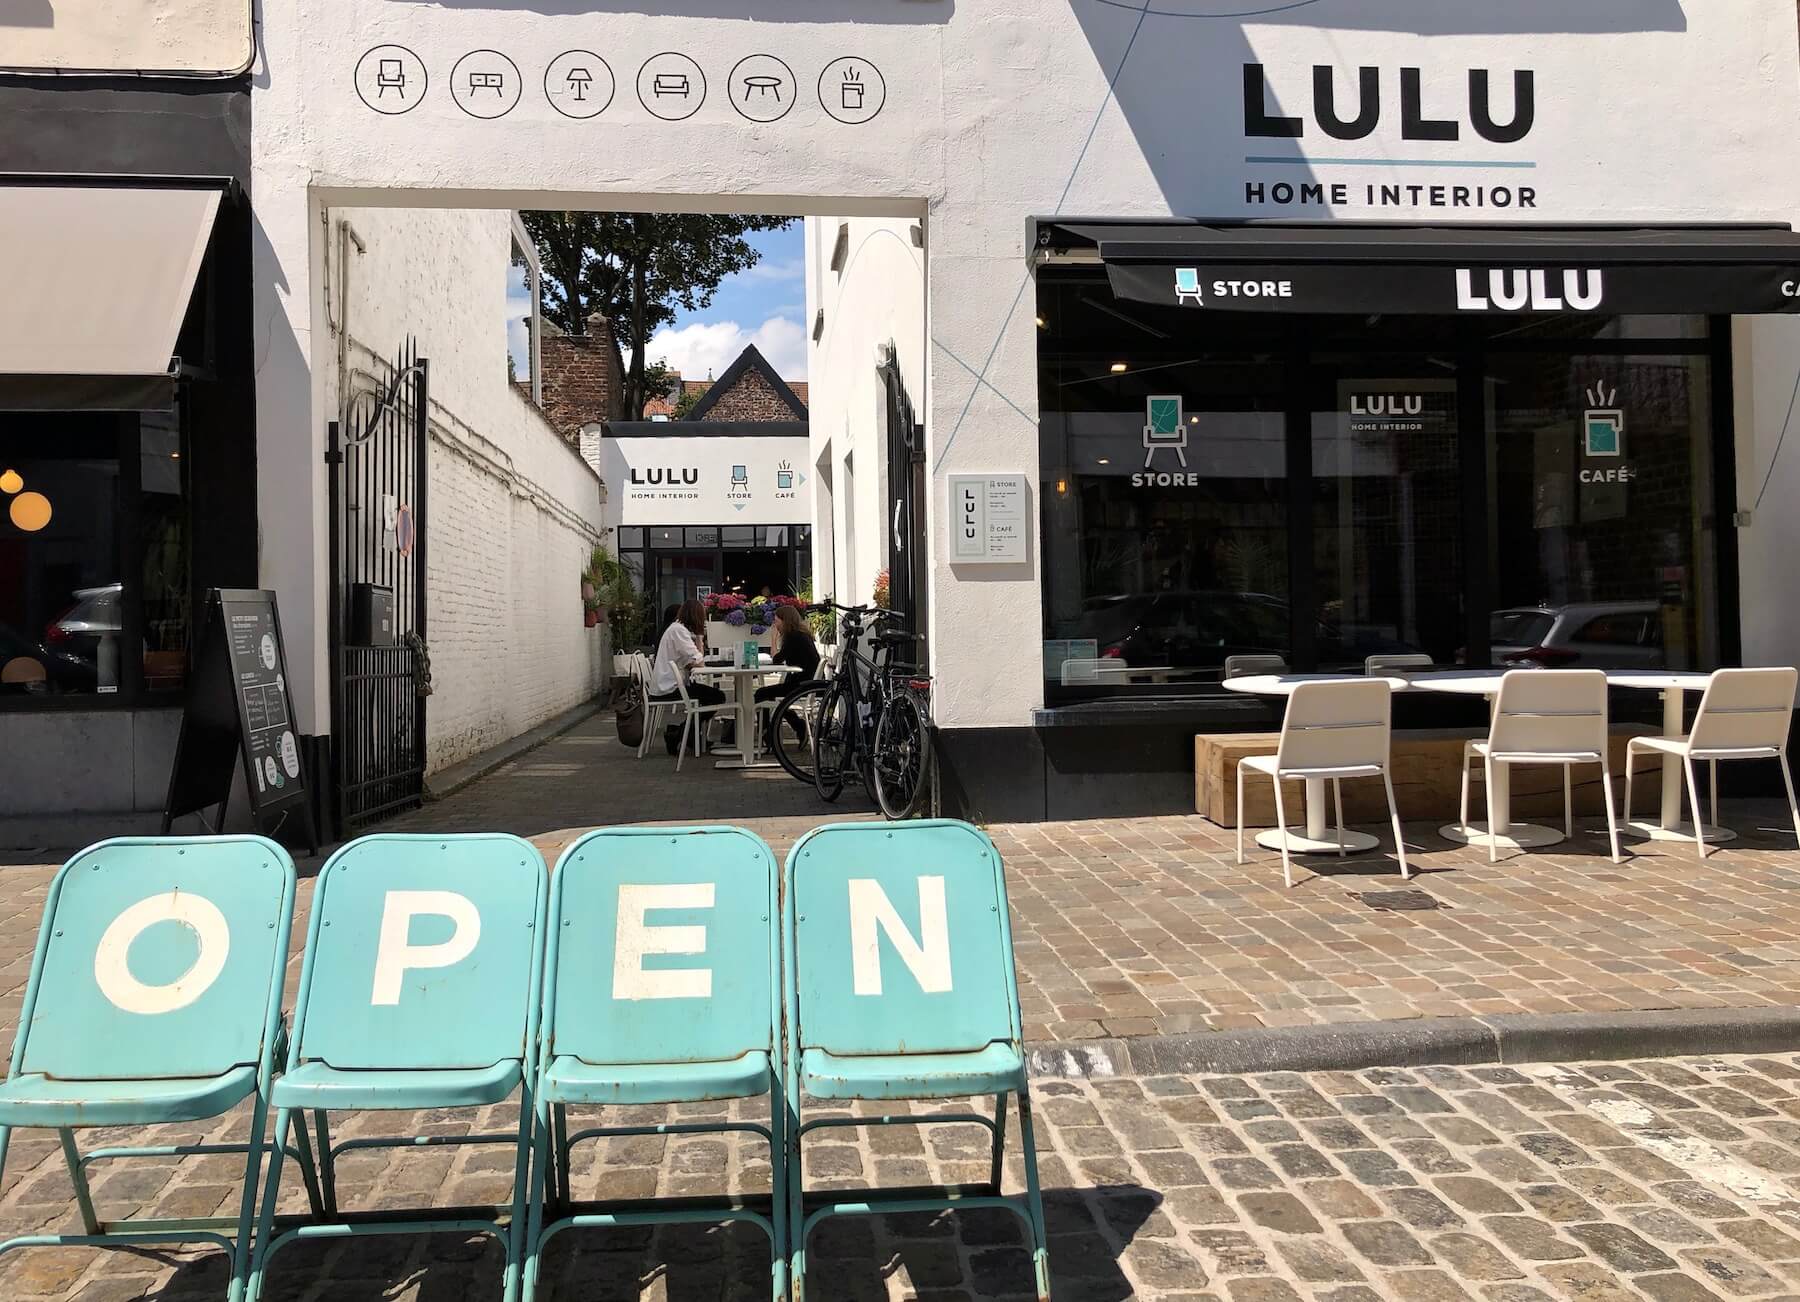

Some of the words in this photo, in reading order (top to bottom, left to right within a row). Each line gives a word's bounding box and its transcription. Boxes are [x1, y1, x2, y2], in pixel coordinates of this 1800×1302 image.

[1243, 63, 1534, 143] LULU
[1246, 183, 1348, 205] HOME
[1367, 184, 1536, 208] INTERIOR
[1212, 280, 1293, 297] STORE
[1455, 269, 1604, 311] LULU
[1350, 395, 1423, 415] LULU
[1351, 423, 1377, 431] HOME
[1380, 423, 1423, 432] INTERIOR
[631, 468, 698, 485] LULU
[1131, 471, 1199, 488] STORE
[1579, 466, 1629, 483] CAFÉ
[965, 489, 976, 538] LULU
[94, 875, 954, 1015] OPEN
